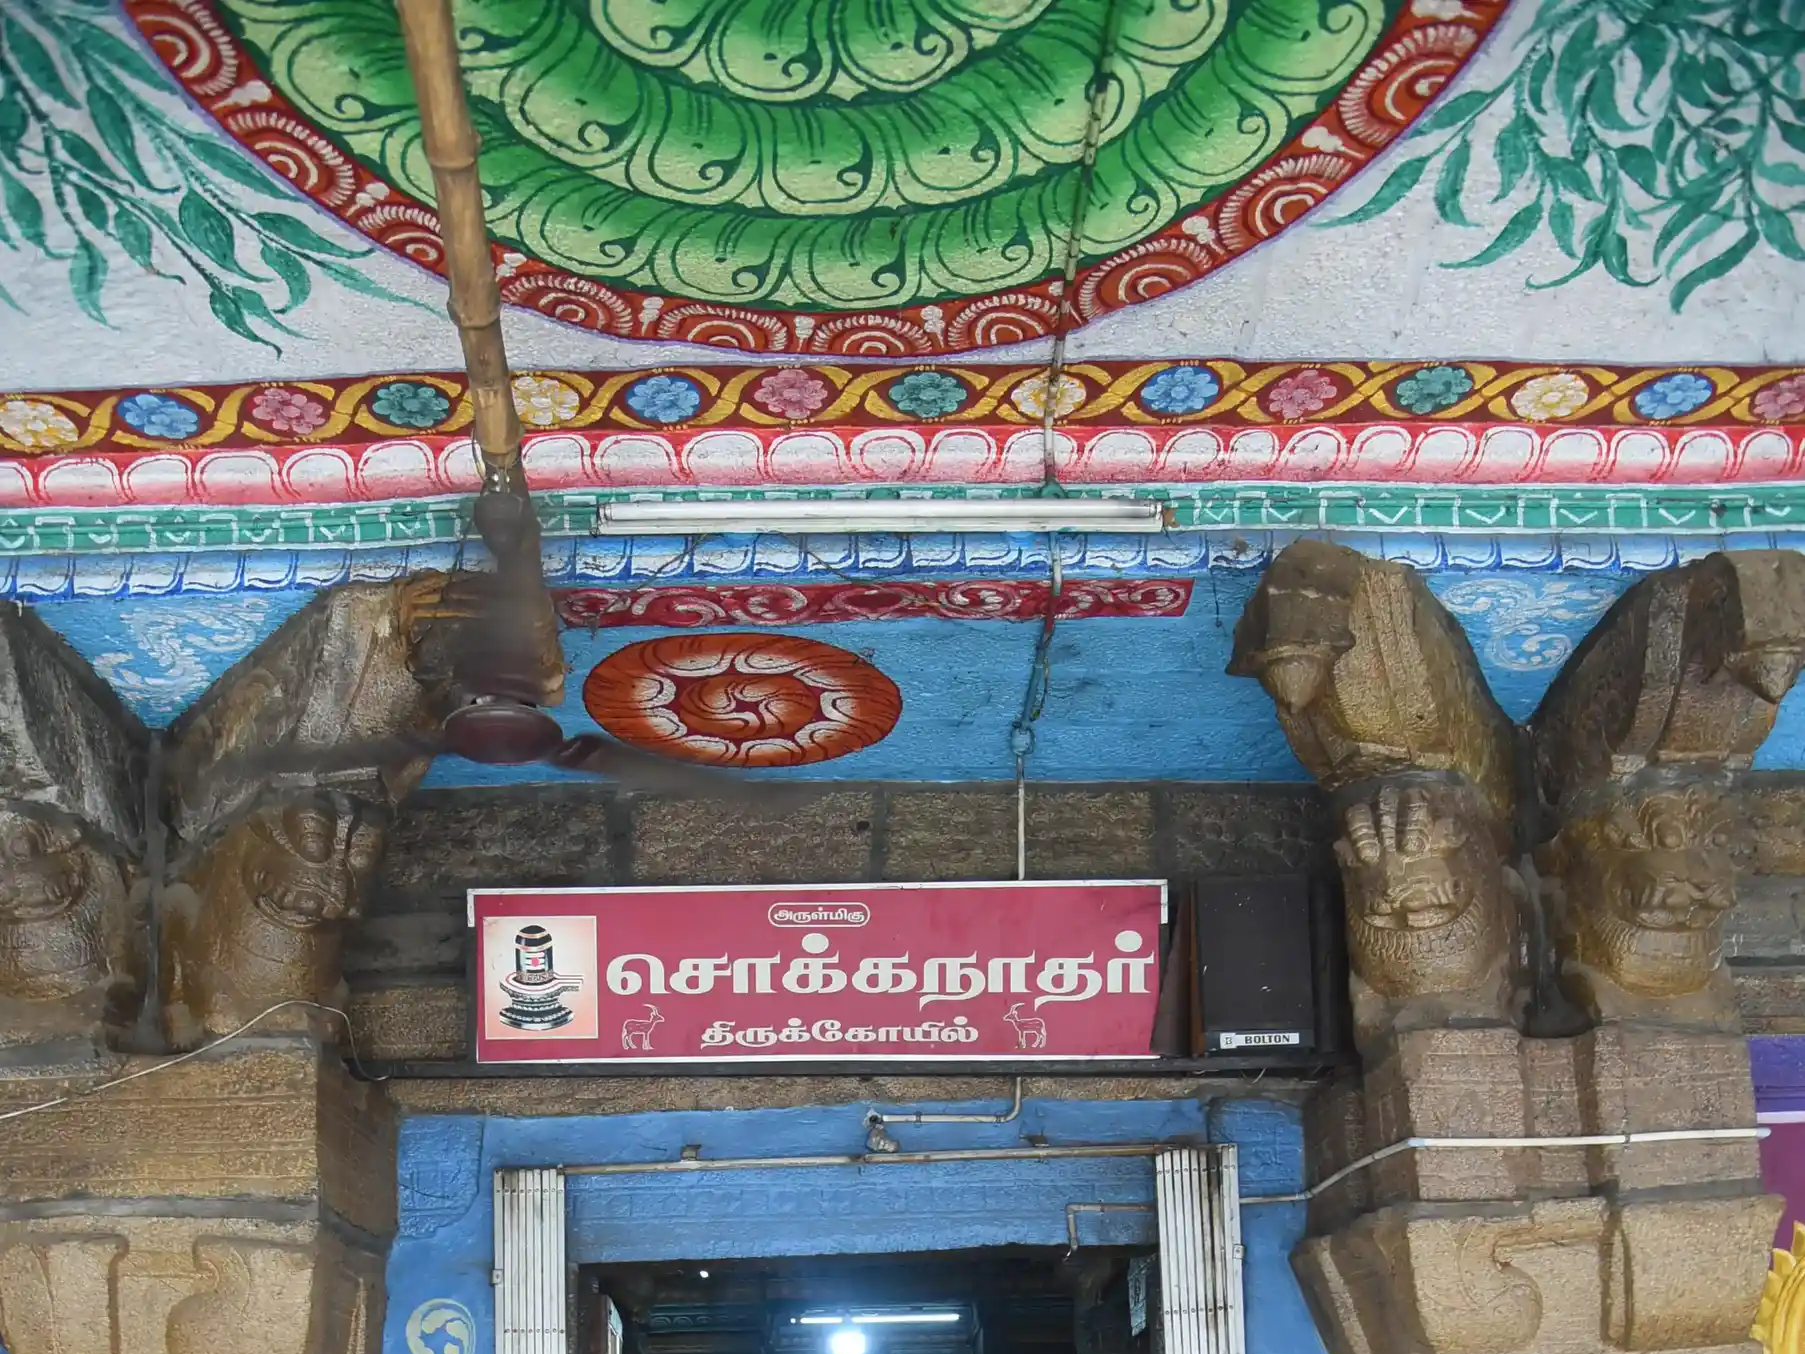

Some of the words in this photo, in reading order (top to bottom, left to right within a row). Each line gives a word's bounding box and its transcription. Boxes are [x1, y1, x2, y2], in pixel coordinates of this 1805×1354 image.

[773, 906, 865, 923] அருள்மிகு
[606, 930, 1154, 1012] சொக்கநாதர்
[700, 1016, 979, 1050] திருக்கோயில்
[1244, 1034, 1291, 1045] BOLTON
